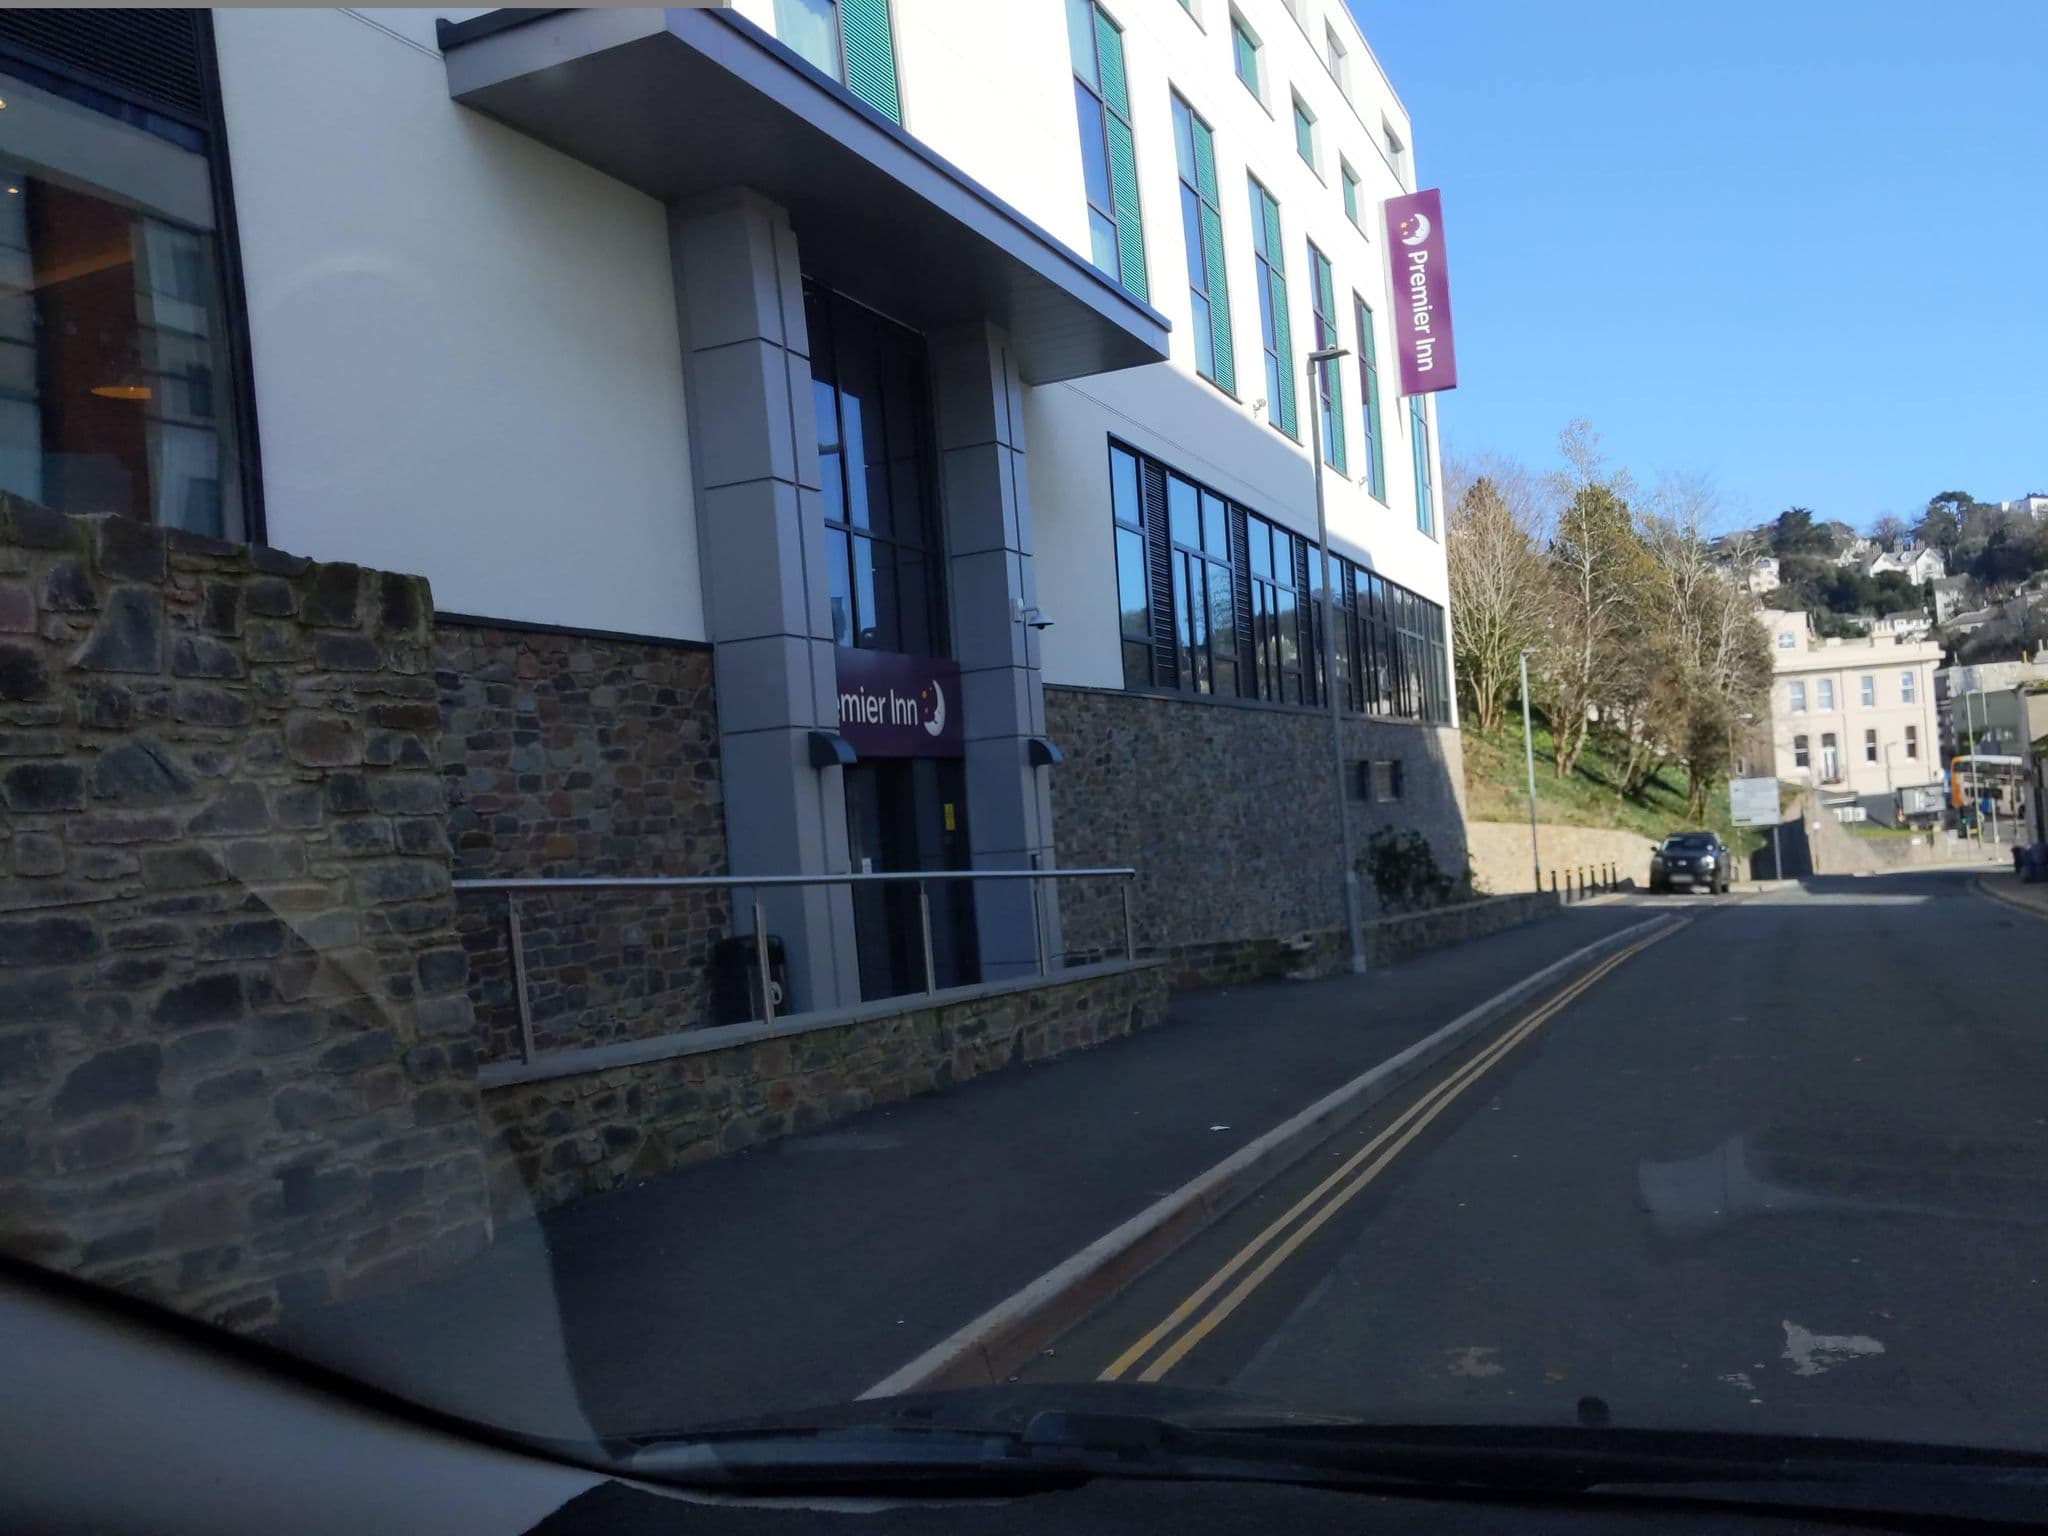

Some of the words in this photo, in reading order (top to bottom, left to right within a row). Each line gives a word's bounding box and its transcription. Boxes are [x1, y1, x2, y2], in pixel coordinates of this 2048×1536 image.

[1408, 250, 1433, 334] Premier
[1416, 337, 1436, 372] Inn
[838, 686, 886, 724] mier
[890, 688, 918, 725] Inn
